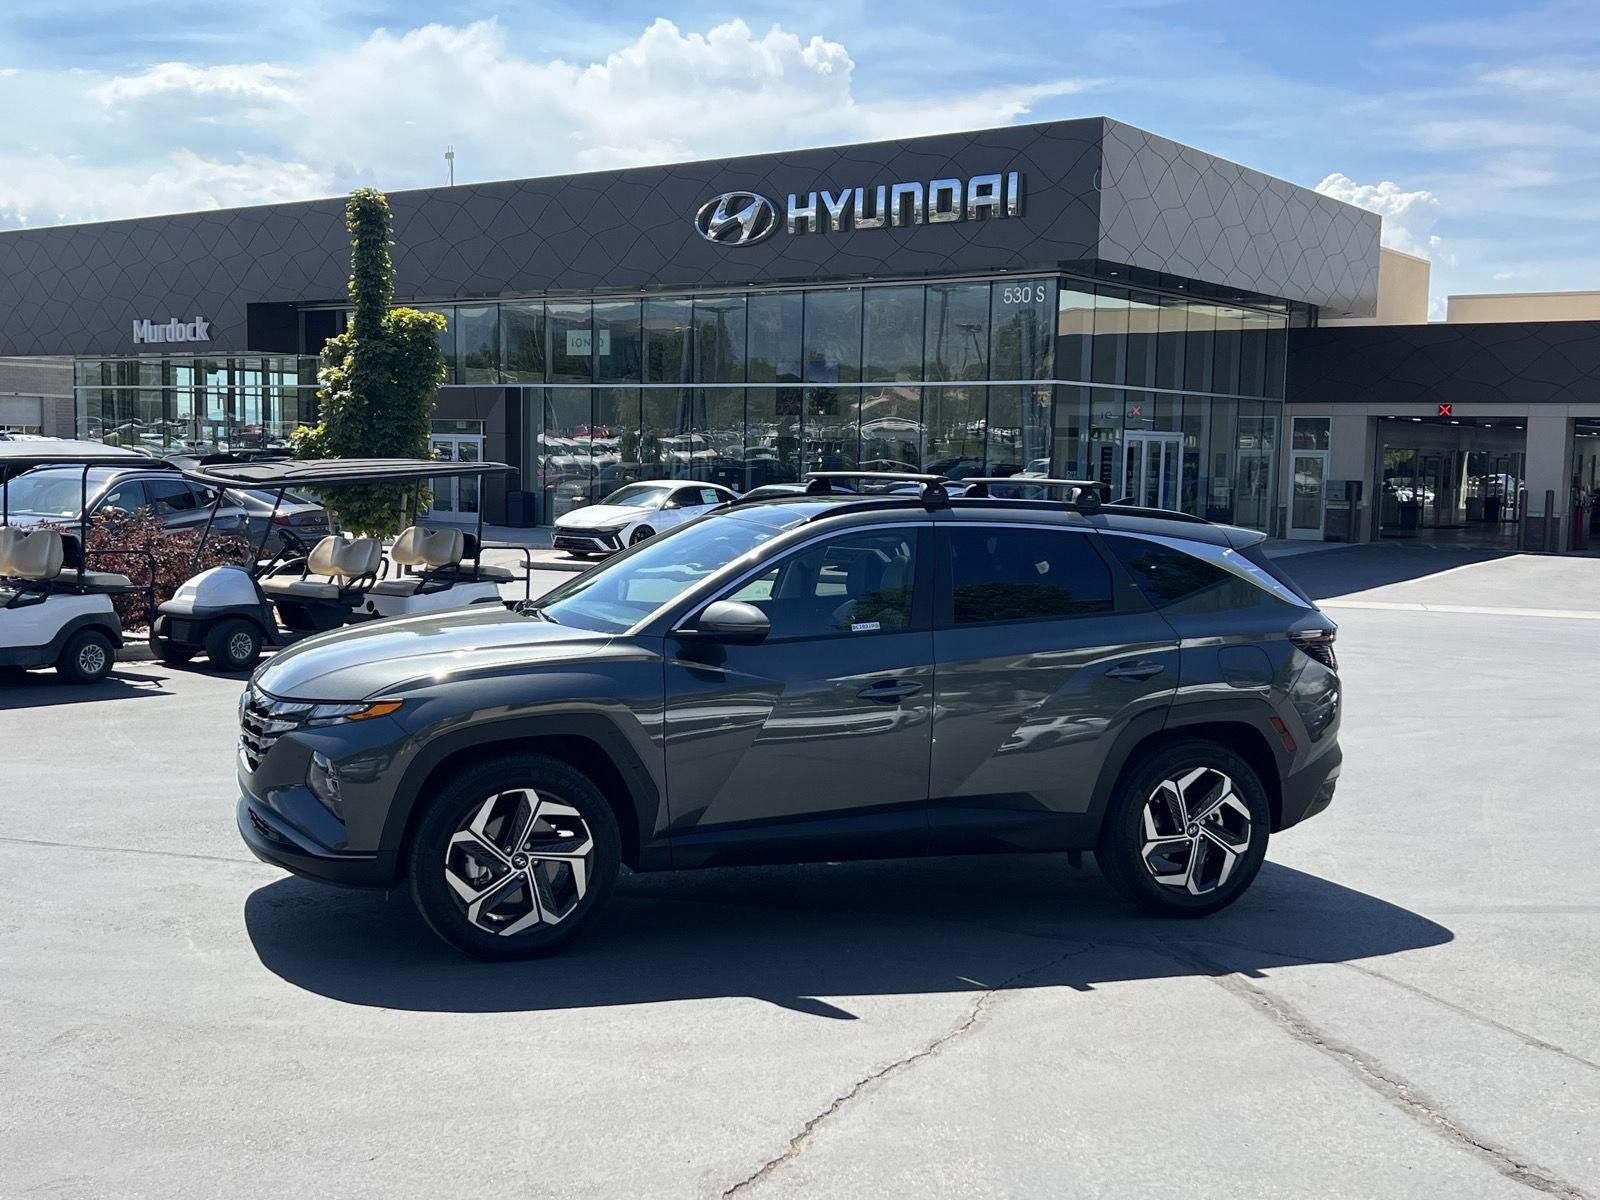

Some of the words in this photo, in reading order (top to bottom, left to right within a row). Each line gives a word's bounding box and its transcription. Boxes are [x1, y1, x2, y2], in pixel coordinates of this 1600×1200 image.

[787, 171, 1023, 235] HYUNDAI
[1003, 287, 1031, 304] 530
[1036, 286, 1045, 303] S
[132, 316, 210, 344] Murdock
